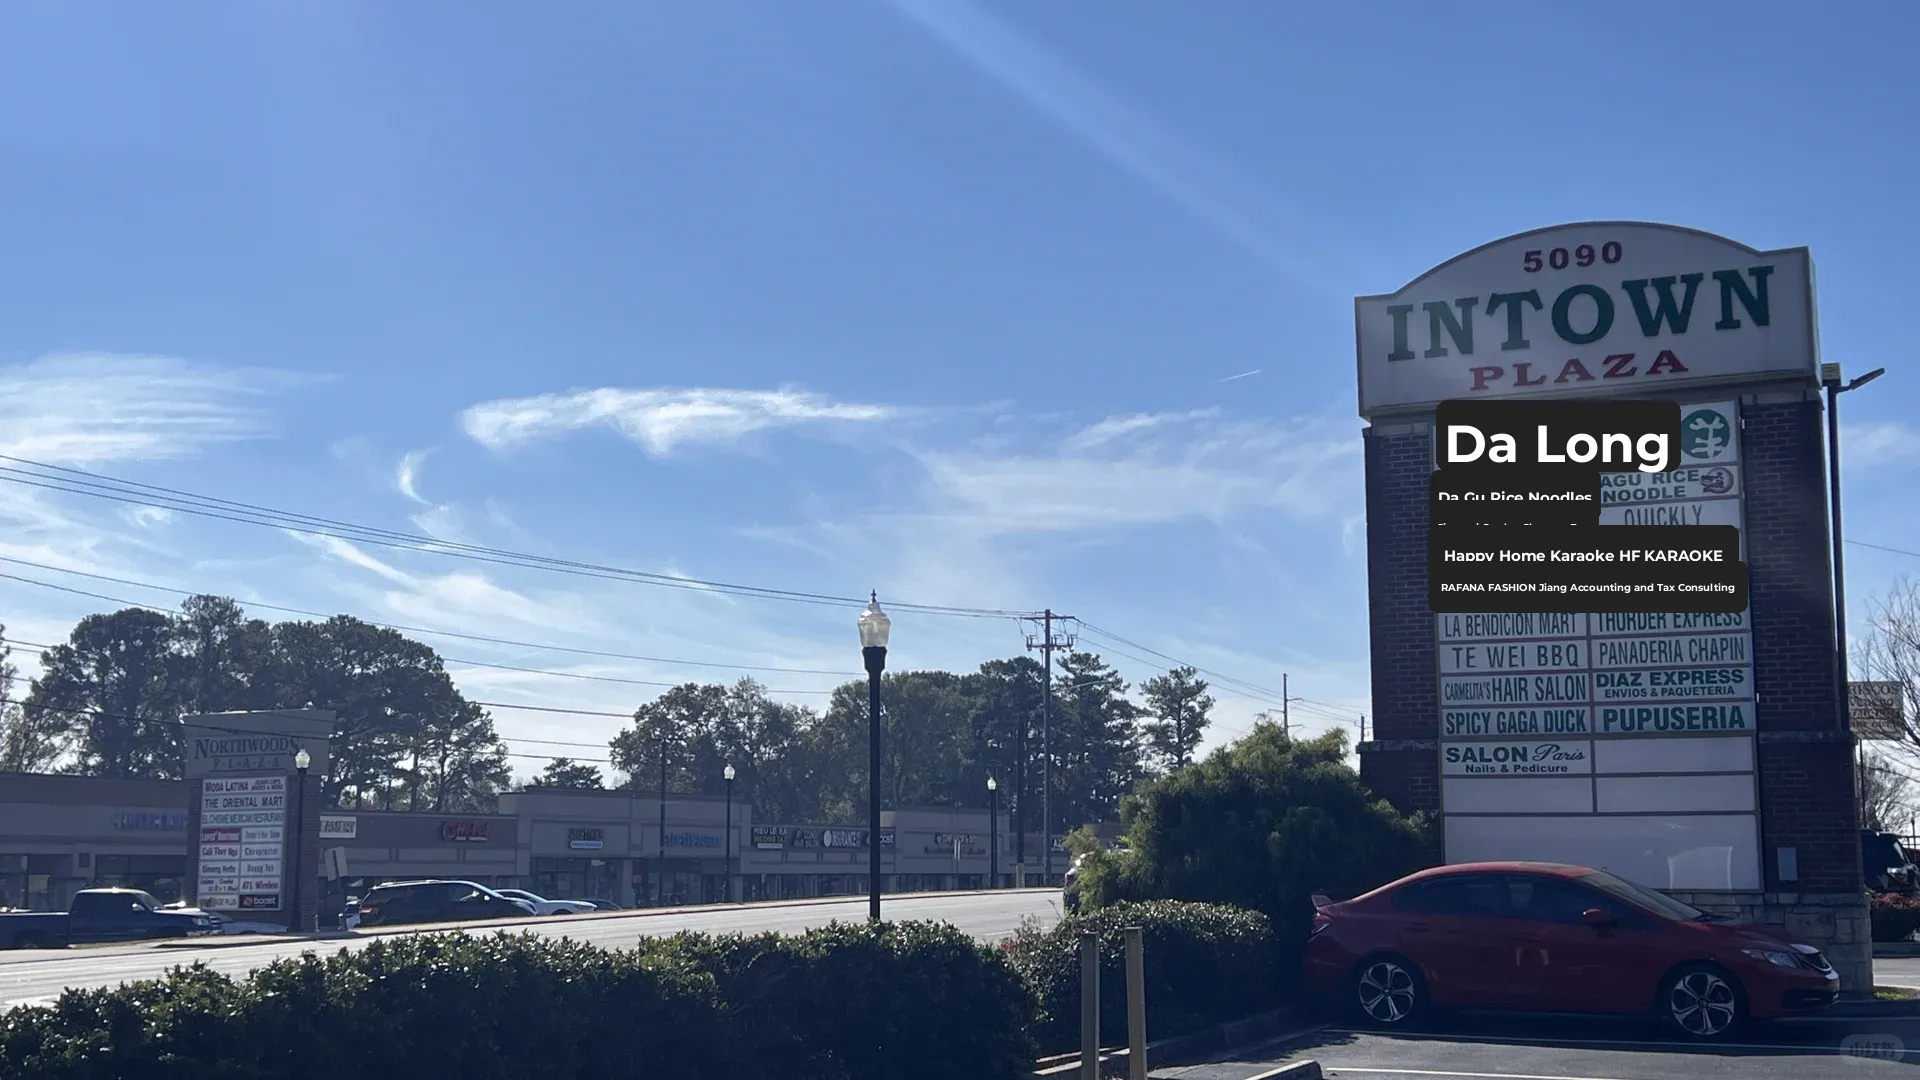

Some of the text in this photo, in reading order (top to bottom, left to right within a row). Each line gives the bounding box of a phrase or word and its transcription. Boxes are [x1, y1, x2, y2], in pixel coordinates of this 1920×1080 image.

[1523, 240, 1623, 273] 5090
[1386, 265, 1775, 362] INTOWN
[1469, 349, 1689, 390] PLAZA
[1652, 469, 1700, 485] RICE
[1603, 486, 1687, 503] NOODLE
[1445, 613, 1577, 638] LA BENDICION MART
[1673, 613, 1743, 629] EXPRESS
[1452, 644, 1580, 669] TE WEI BBQ
[1599, 637, 1745, 665] PANADERIA CHAPIN
[1445, 675, 1586, 702] CARMELITA'S HAIR SALON
[1596, 669, 1745, 688] DIAZ EXPRESS
[1604, 685, 1736, 699] ENVIOS & PAQUETERIA
[1446, 709, 1587, 735] SPICY GAGA DUCK
[1603, 705, 1746, 733] PUPUSERIA
[194, 737, 300, 760] NORTHWOODS
[1446, 743, 1587, 763] SALON Paris
[1465, 764, 1568, 774] Nails & Pedicure
[205, 781, 249, 792] MODA LATINA
[205, 796, 284, 808] THE ORIENTAL MART
[230, 813, 253, 824] MEXICAN
[253, 812, 284, 823] RESTAURANT
[253, 896, 276, 905] boost
